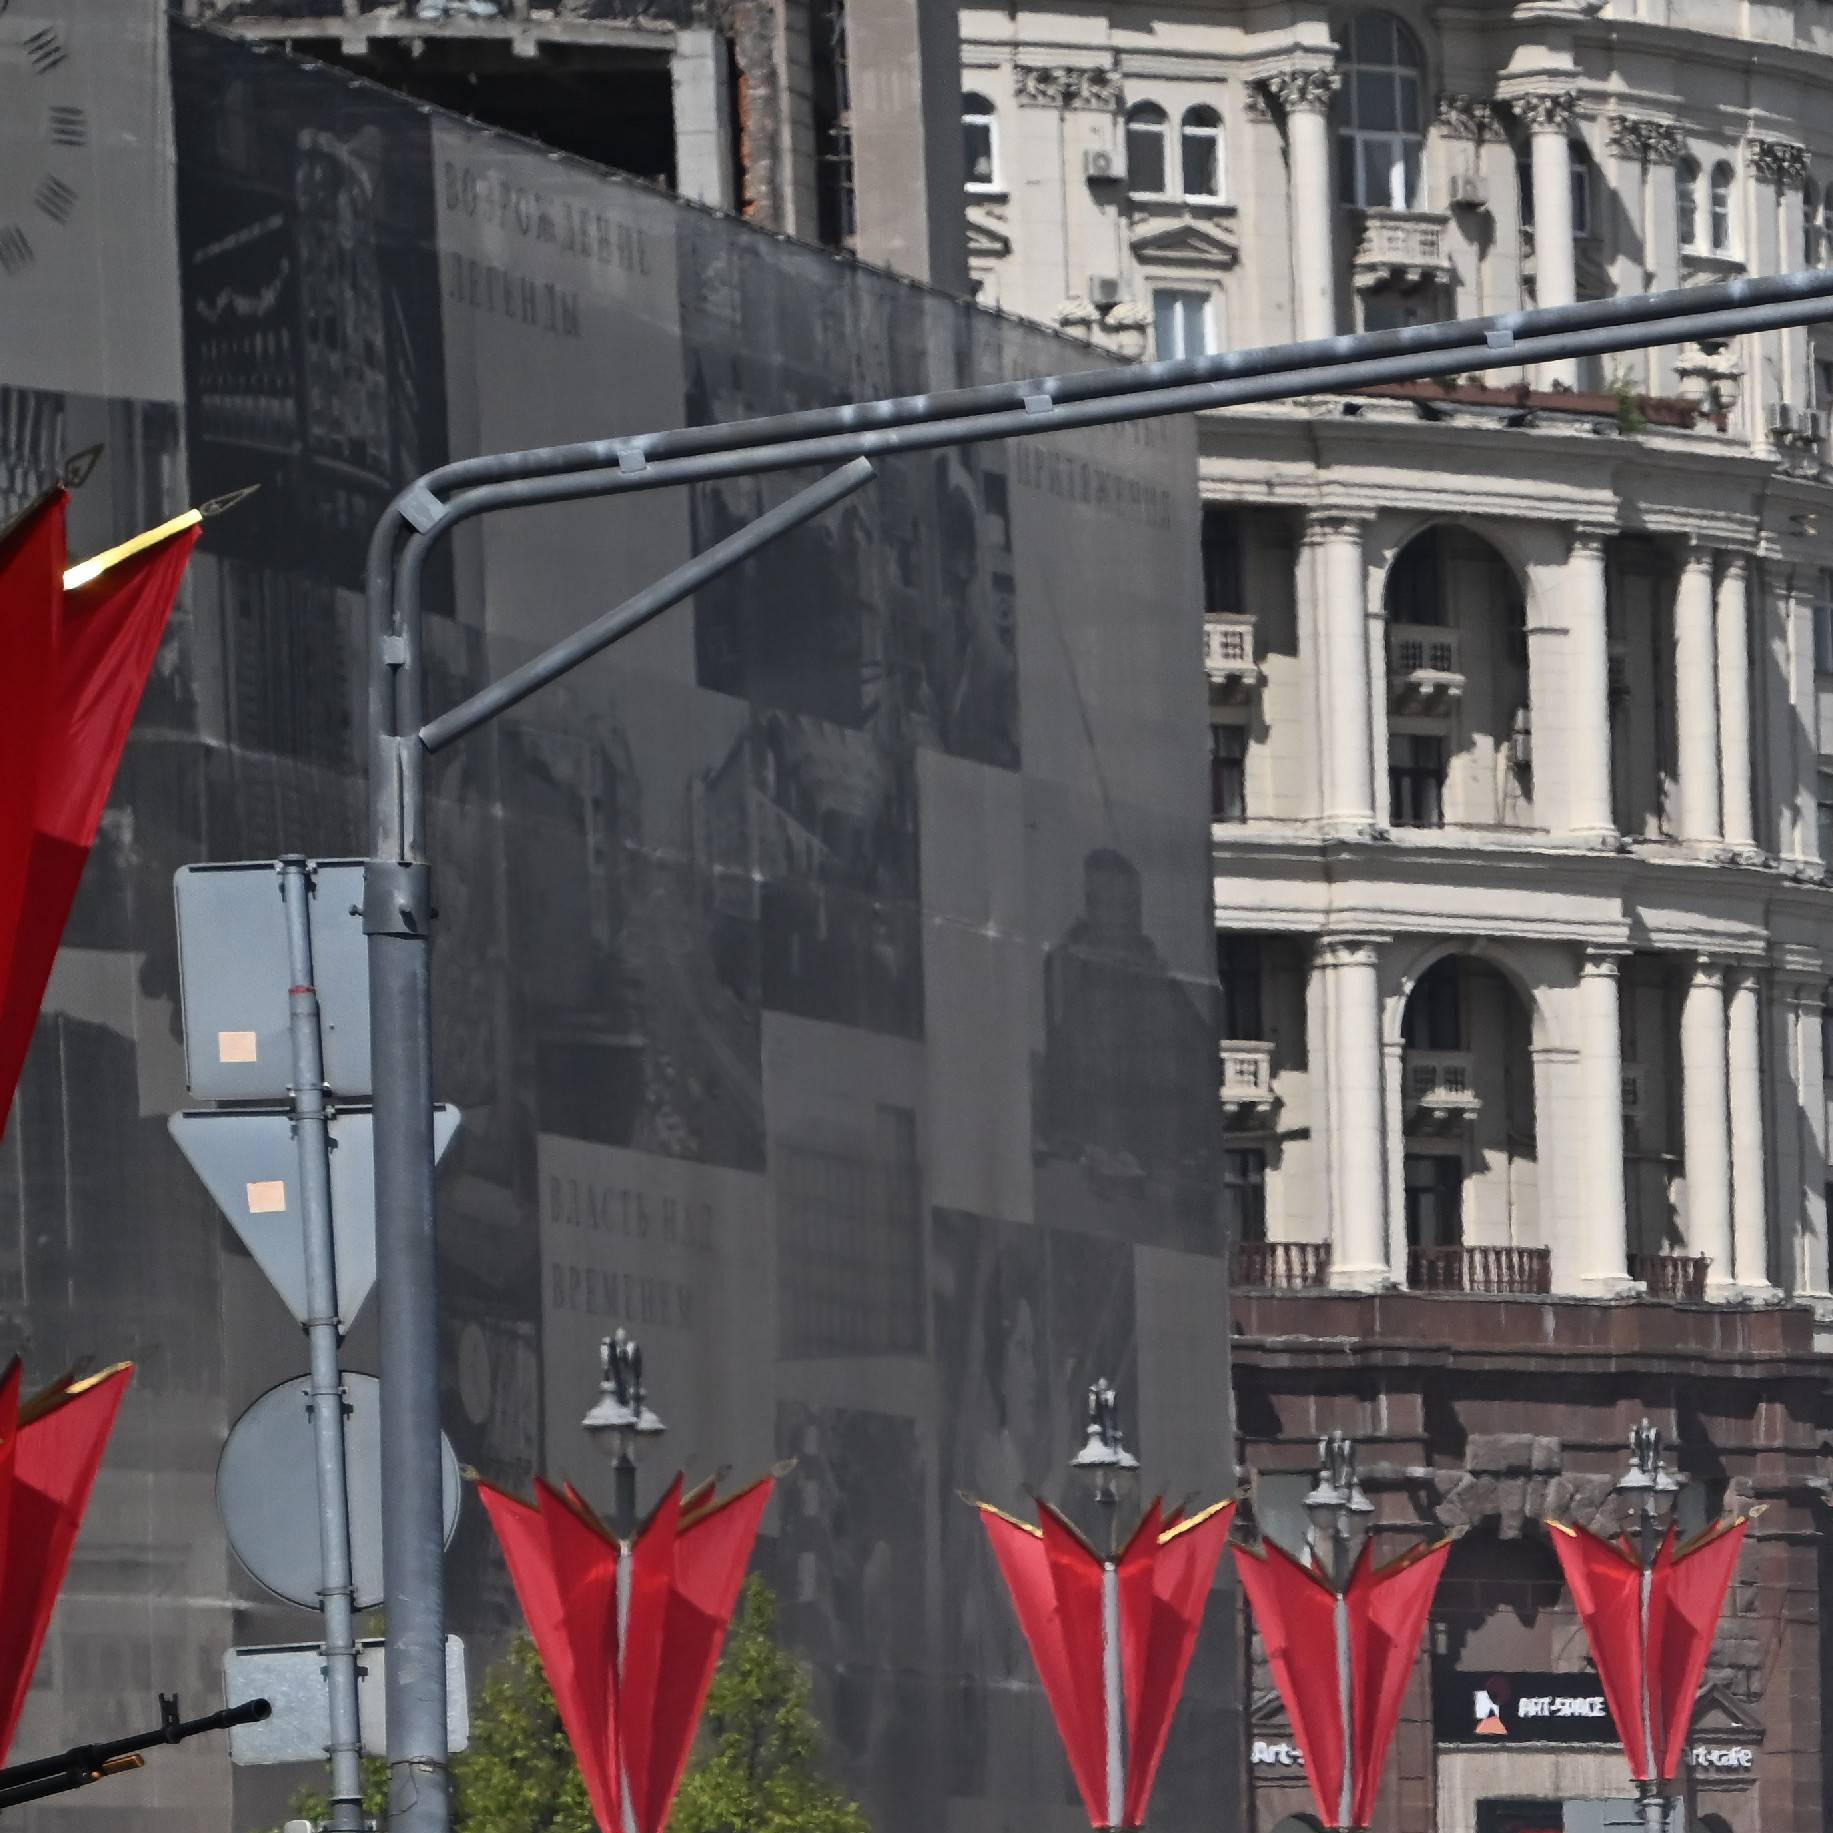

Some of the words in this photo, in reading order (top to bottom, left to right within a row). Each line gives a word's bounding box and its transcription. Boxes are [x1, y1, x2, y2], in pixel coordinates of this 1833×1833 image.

[447, 251, 582, 337] ЛЕГЕНДЫ
[549, 1175, 650, 1239] ВЛАСТЬ
[1518, 1696, 1606, 1718] ART-SPACE
